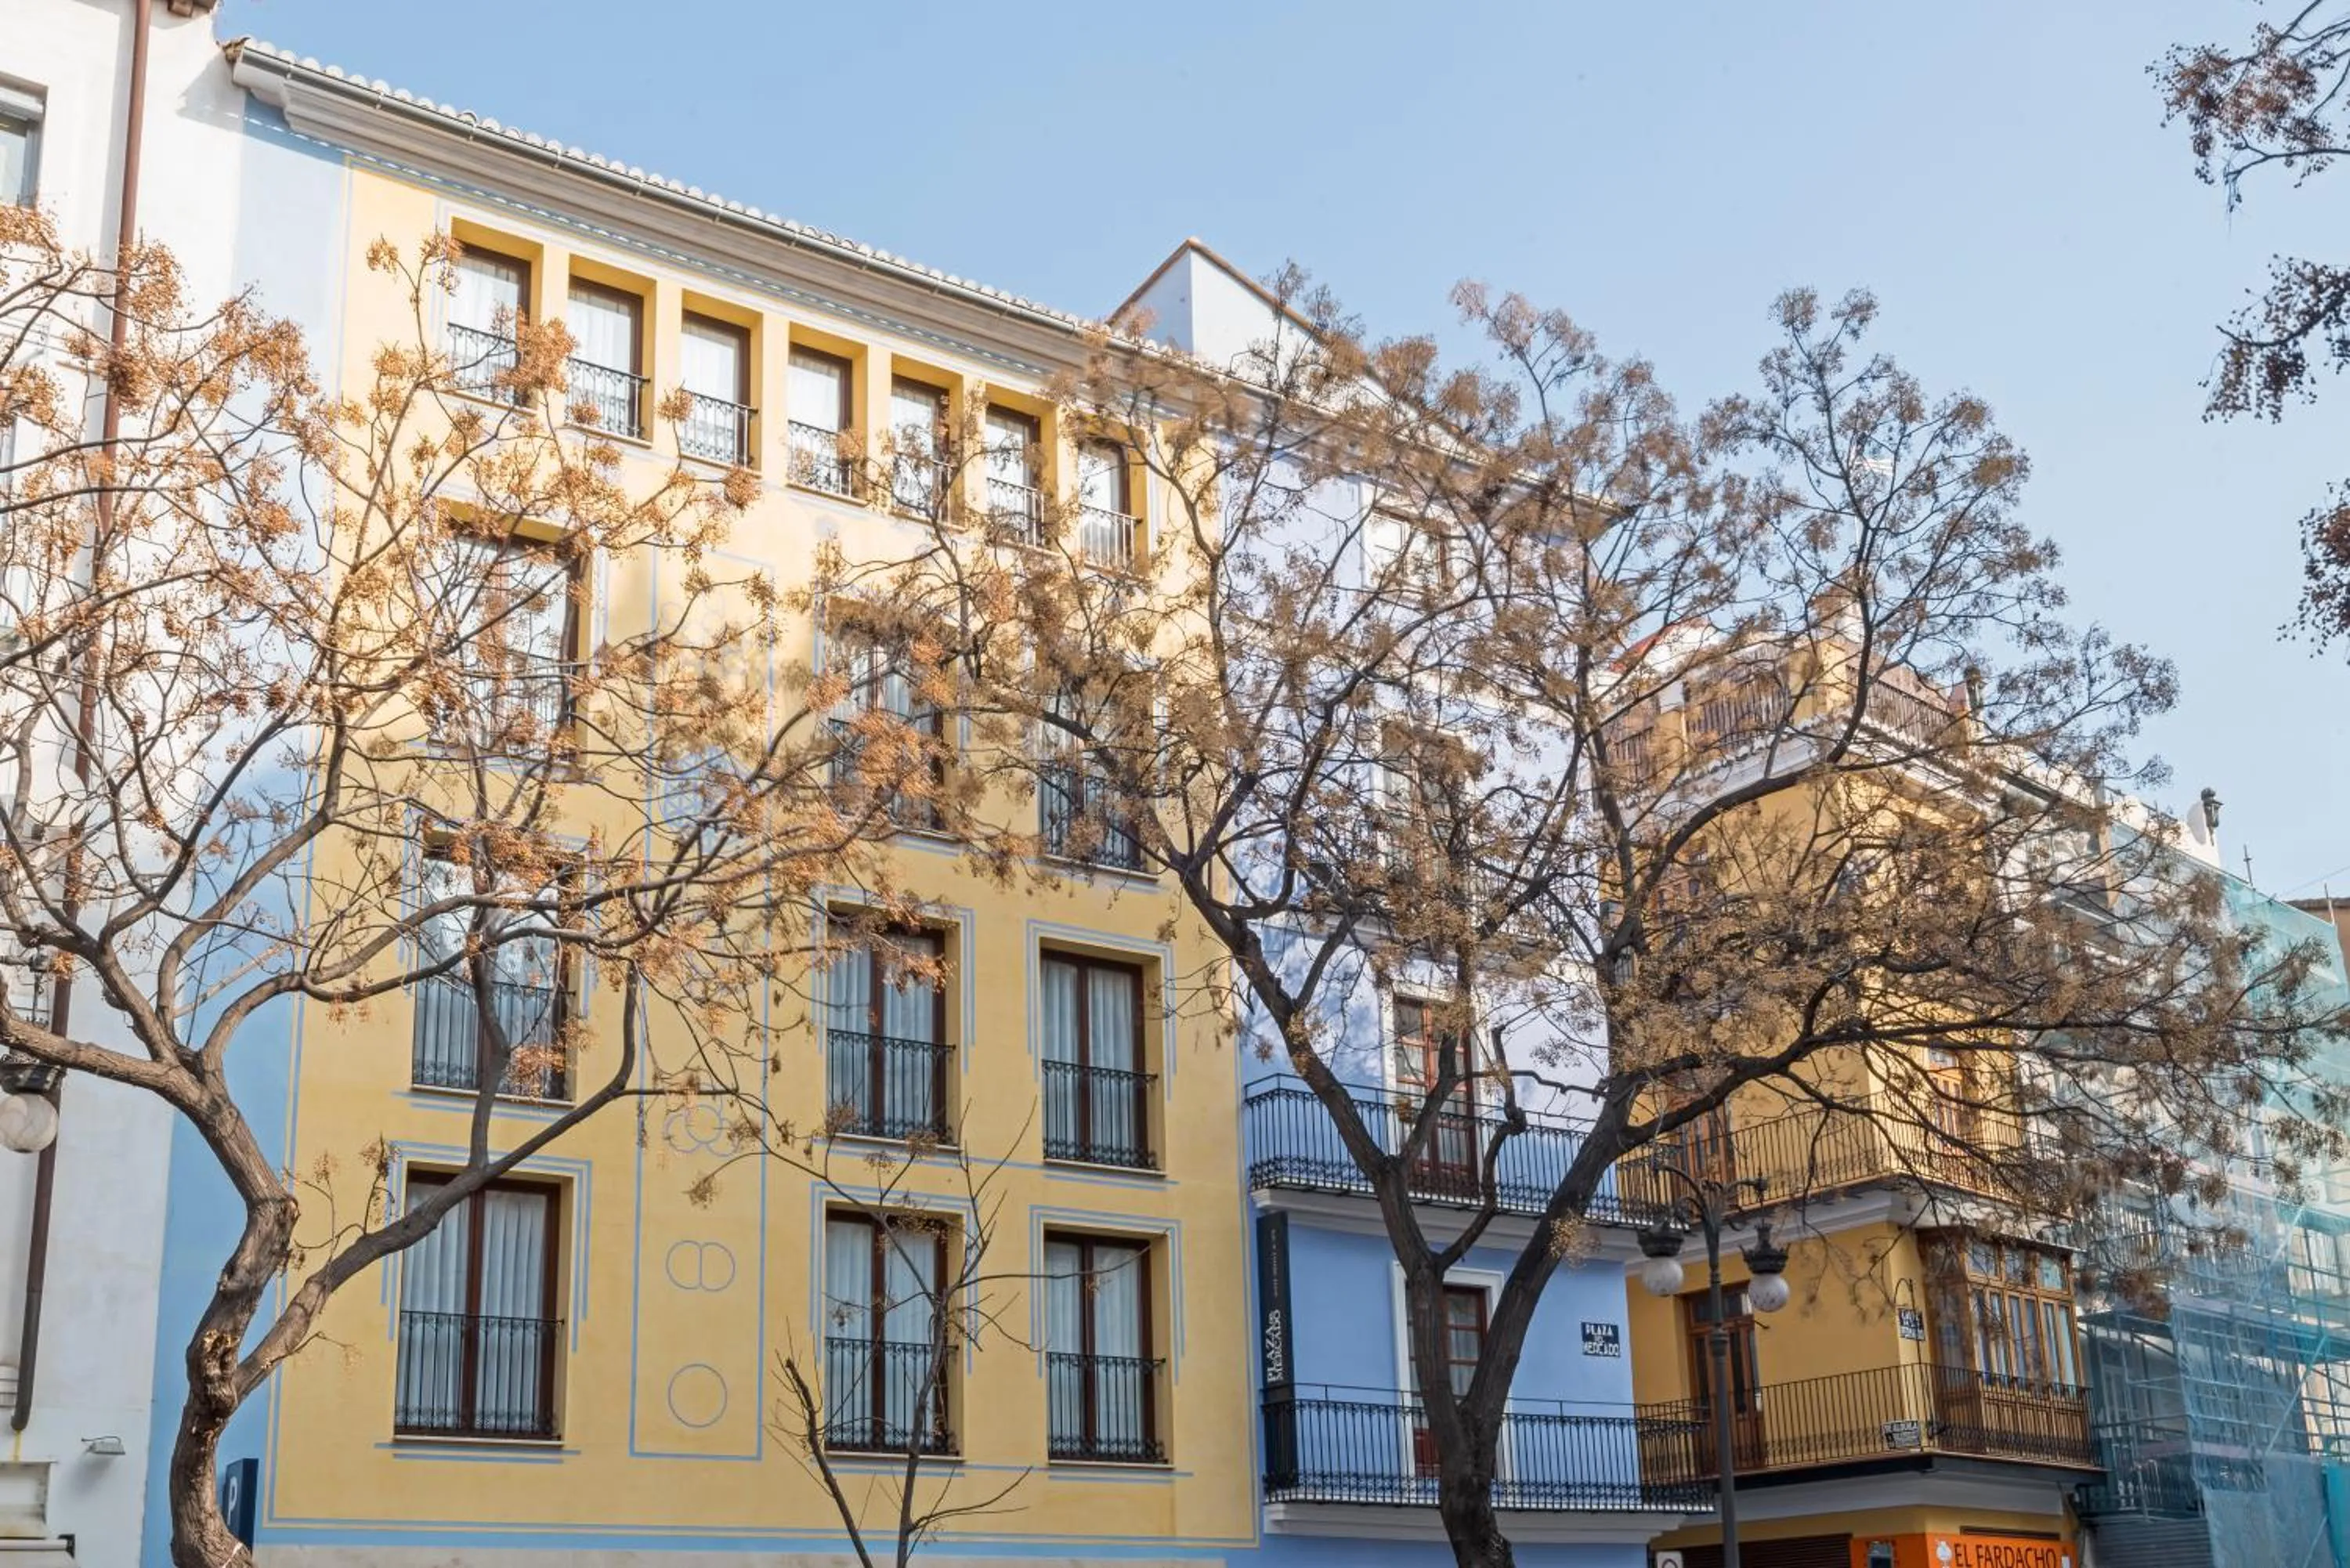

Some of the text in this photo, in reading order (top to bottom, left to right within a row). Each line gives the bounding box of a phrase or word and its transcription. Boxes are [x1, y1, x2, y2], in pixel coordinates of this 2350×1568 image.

[1585, 1324, 1614, 1335] PLAZA
[1266, 1326, 1276, 1382] PLAZA
[1584, 1342, 1619, 1355] MERCADO
[227, 1476, 238, 1526] P
[1954, 1543, 2056, 1568] EL FARDACHO
